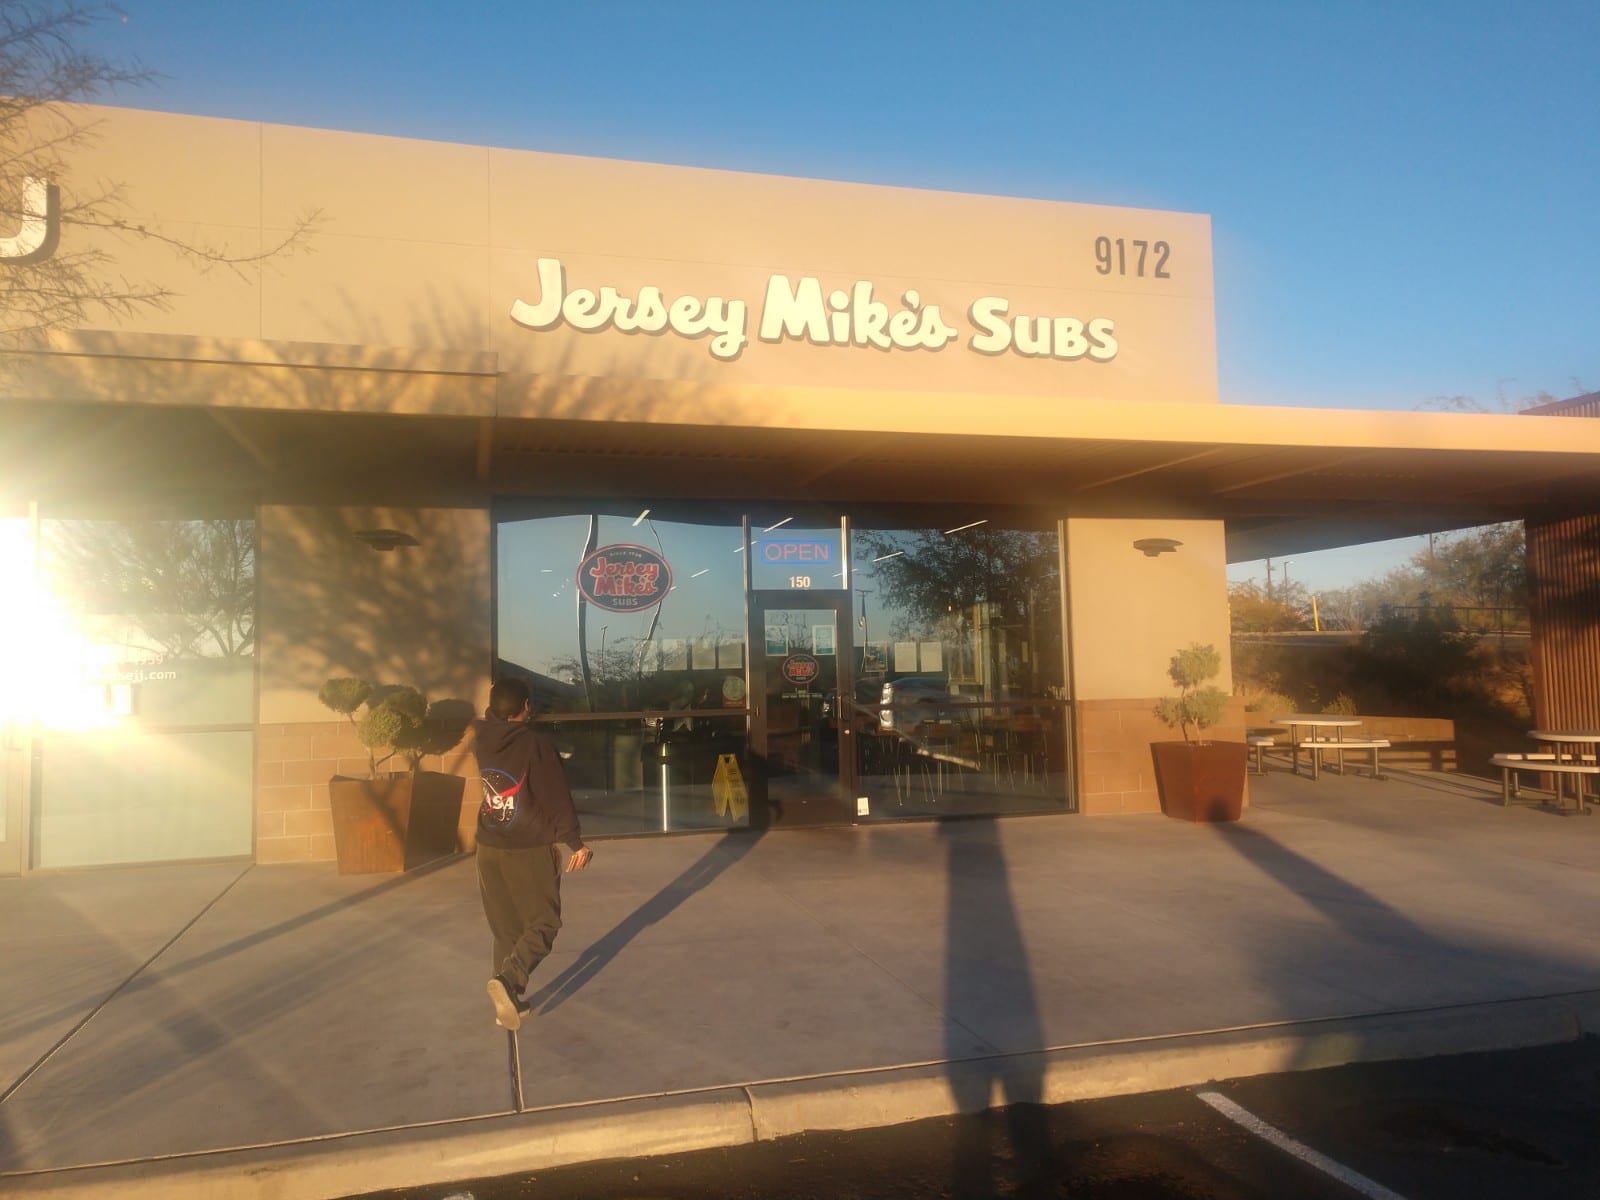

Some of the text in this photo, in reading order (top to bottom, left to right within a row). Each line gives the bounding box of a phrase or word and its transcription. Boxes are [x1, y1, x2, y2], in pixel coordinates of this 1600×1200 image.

[1095, 236, 1170, 279] 9172
[509, 257, 747, 360] Jersey
[760, 274, 958, 349] Mike's
[765, 543, 829, 561] OPEN
[589, 556, 659, 581] Jersey
[789, 576, 811, 588] 150
[612, 598, 638, 606] SUBS
